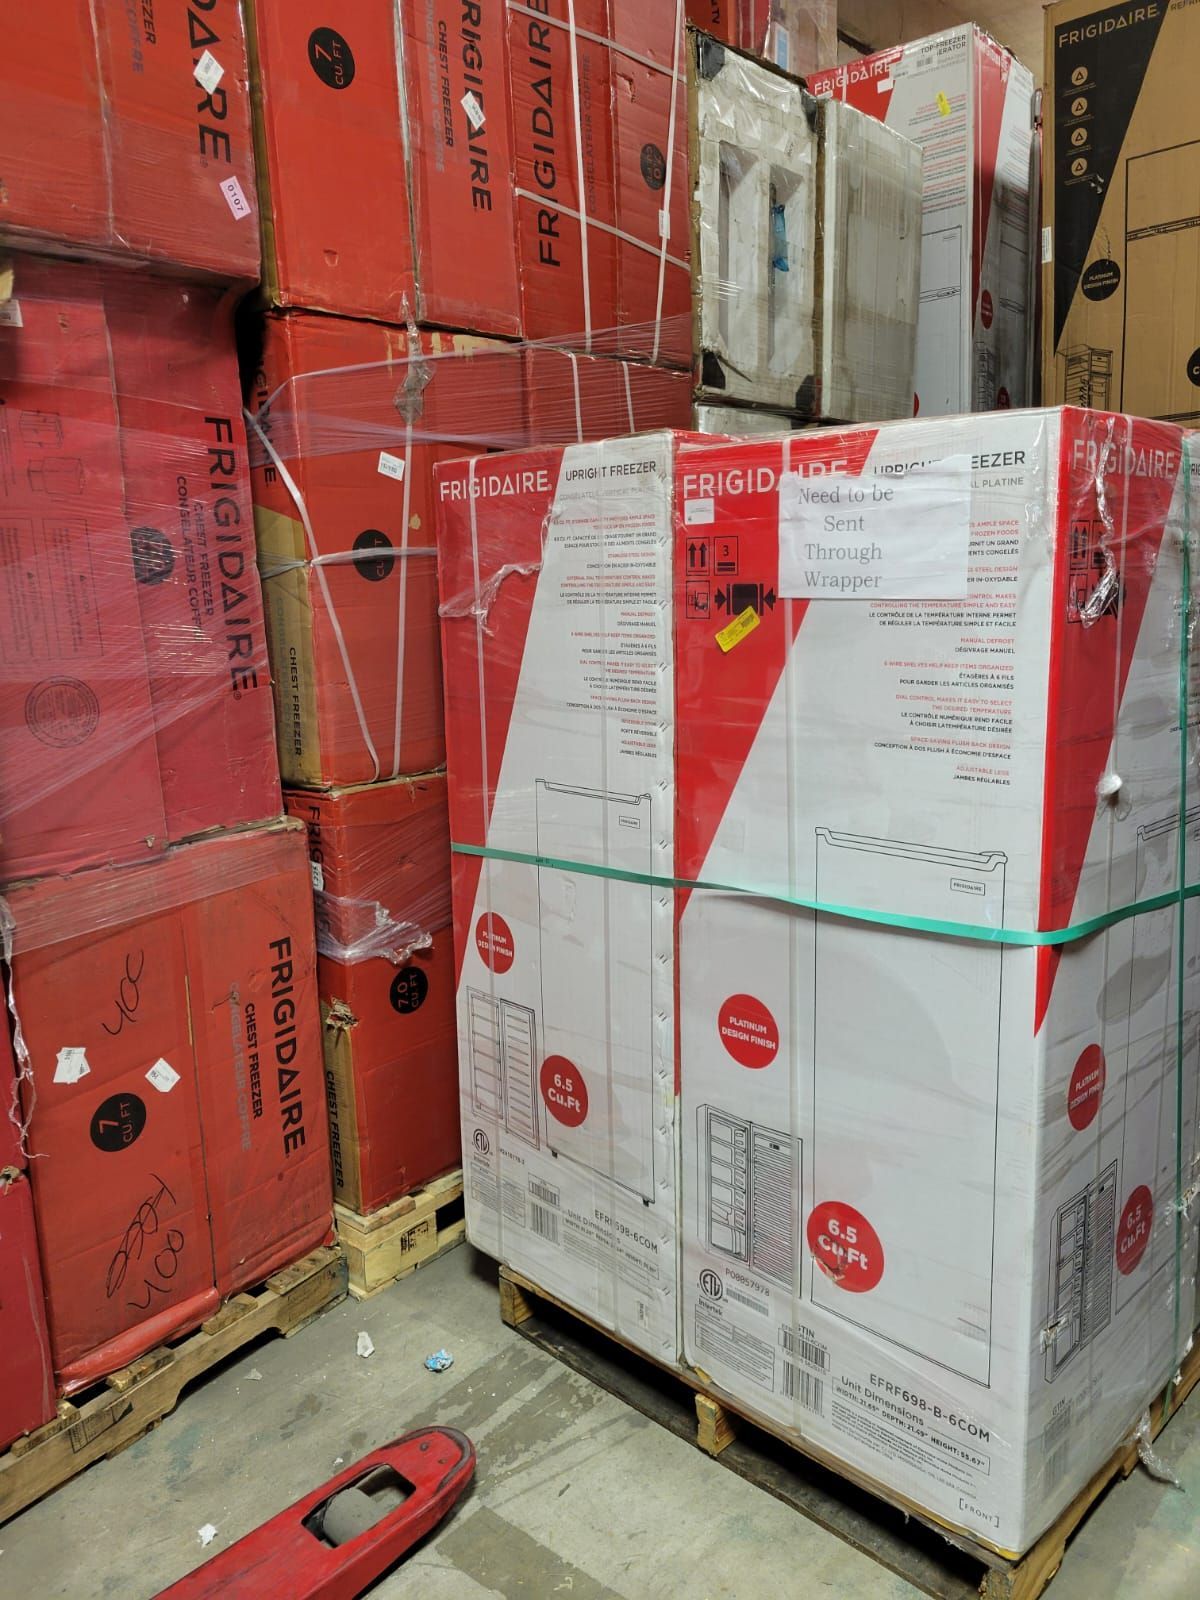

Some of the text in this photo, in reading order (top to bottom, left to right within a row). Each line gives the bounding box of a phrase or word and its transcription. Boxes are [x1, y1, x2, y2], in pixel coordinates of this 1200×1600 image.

[1058, 3, 1160, 48] FRIGIDAIRE
[315, 43, 332, 62] 7
[332, 40, 342, 58] FT
[921, 34, 967, 54] TOP-FREEZER
[438, 20, 454, 148] CHEST FREEZER
[814, 61, 891, 96] FRIGIDAIRE
[226, 184, 245, 212] 0107
[565, 461, 656, 481] UPRIGHT FREEZER
[971, 450, 1026, 469] EEZER
[440, 470, 550, 501] FRIGIDAIRE
[798, 484, 894, 505] Need to be
[983, 477, 1024, 489] PLATINE
[176, 475, 197, 585] CONGELATEUR
[824, 515, 865, 533] Sent
[204, 416, 258, 690] FRIGIDAIRE
[722, 544, 730, 557] 3
[805, 543, 883, 565] Through
[200, 552, 214, 616] FREEZER
[805, 571, 883, 593] Wrapper
[289, 646, 302, 757] CHEST FREEZER
[729, 1016, 767, 1034] PLATINUM
[269, 936, 306, 1154] FRIGIDAIRE
[721, 1027, 776, 1050] DESIGN FINISH
[245, 1002, 263, 1120] CHEST FREEZER
[553, 1073, 573, 1092] 6.5
[120, 1102, 131, 1118] FT
[547, 1090, 581, 1113] Cu.Ft
[99, 1120, 119, 1134] 7
[326, 1070, 344, 1189] CHEST FREEZER
[1127, 1204, 1142, 1228] 6.5
[827, 1218, 858, 1244] 6.5
[1120, 1223, 1146, 1254] Cu.Ft
[799, 1324, 815, 1338] TIN
[841, 1375, 924, 1426] Unit Dimensions
[869, 1373, 990, 1443] EFRF698-B-6COM
[836, 1386, 859, 1403] WIDTH:
[881, 1410, 907, 1428] DEPTH:
[931, 1437, 960, 1455] HEIGHT:
